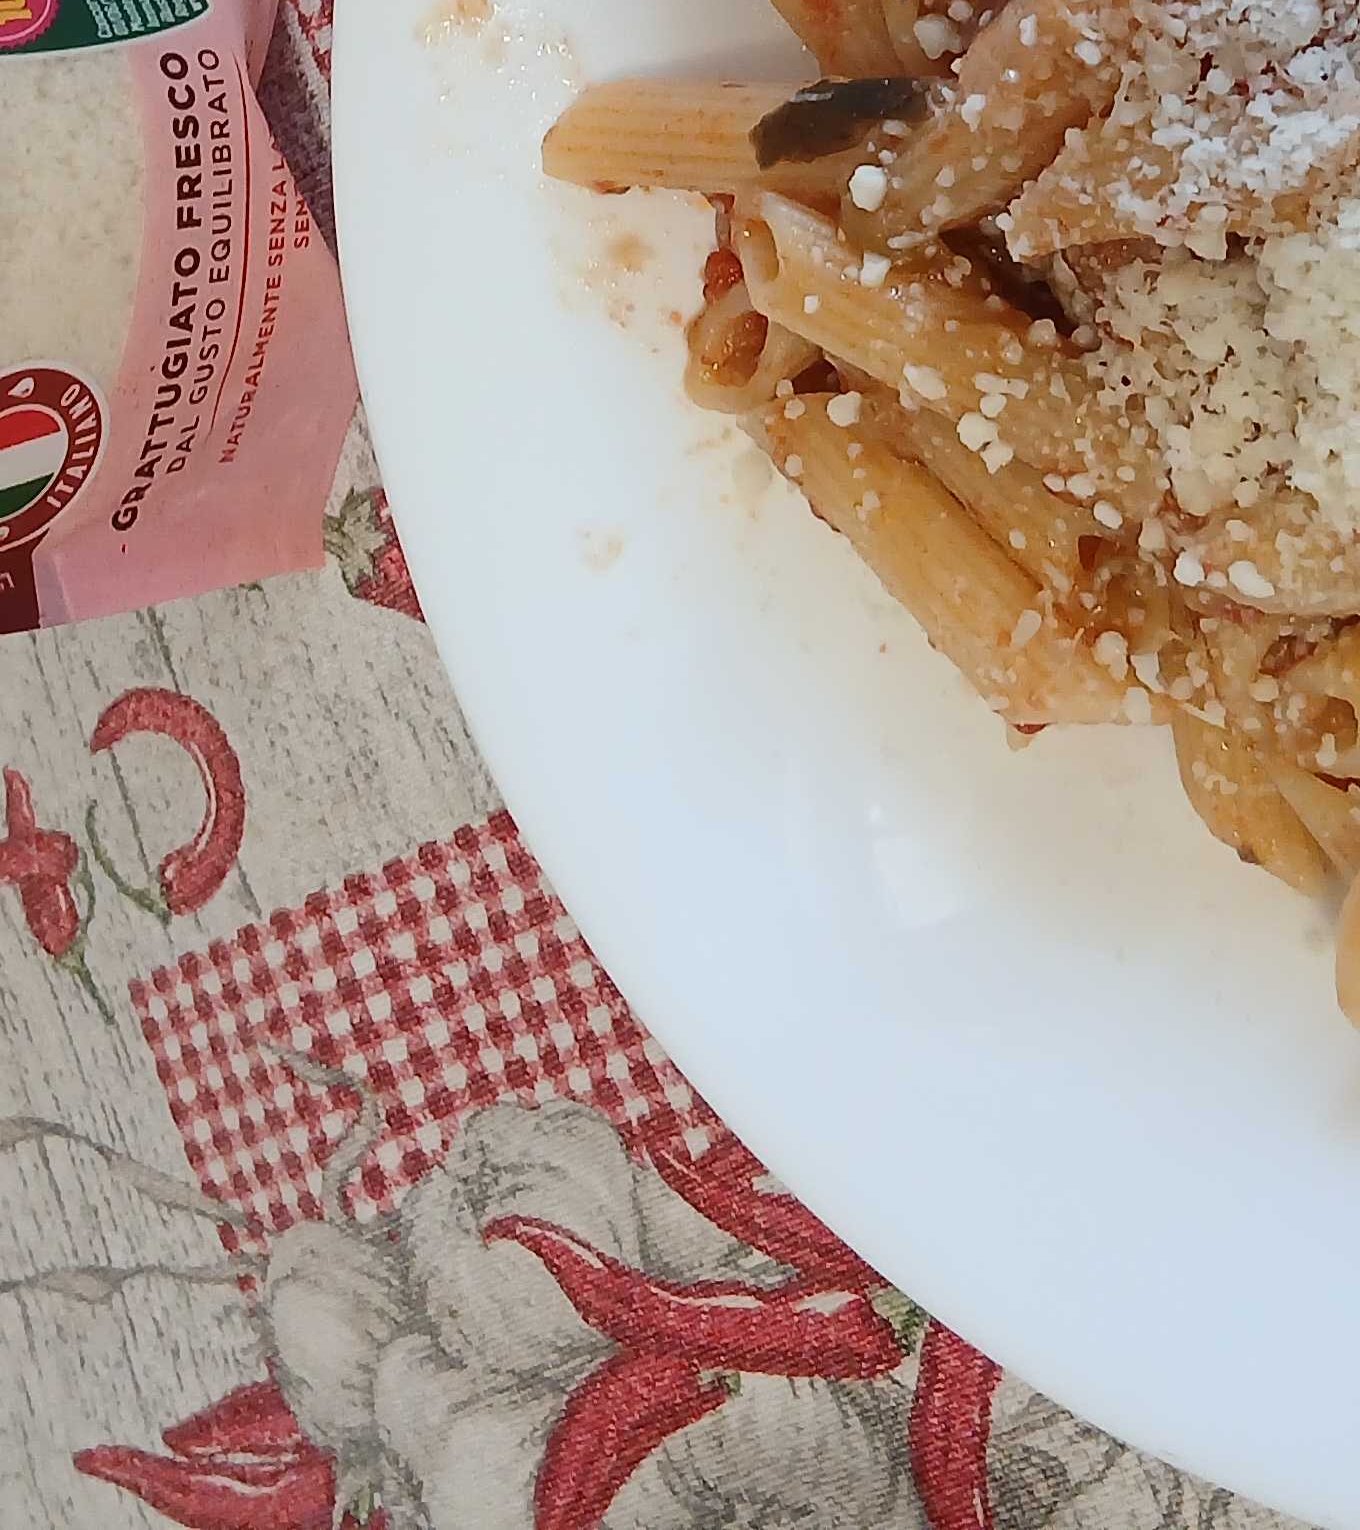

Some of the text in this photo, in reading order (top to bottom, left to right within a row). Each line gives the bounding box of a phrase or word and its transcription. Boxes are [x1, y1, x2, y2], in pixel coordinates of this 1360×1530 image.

[111, 247, 201, 532] GRATTUGIATO
[159, 52, 203, 230] FRESCO
[165, 48, 233, 474] DAL GUSTO EQUILIBRATO
[218, 274, 282, 464] NATURALMENTE
[268, 180, 287, 267] SENZA
[45, 383, 98, 509] ITALIANO
